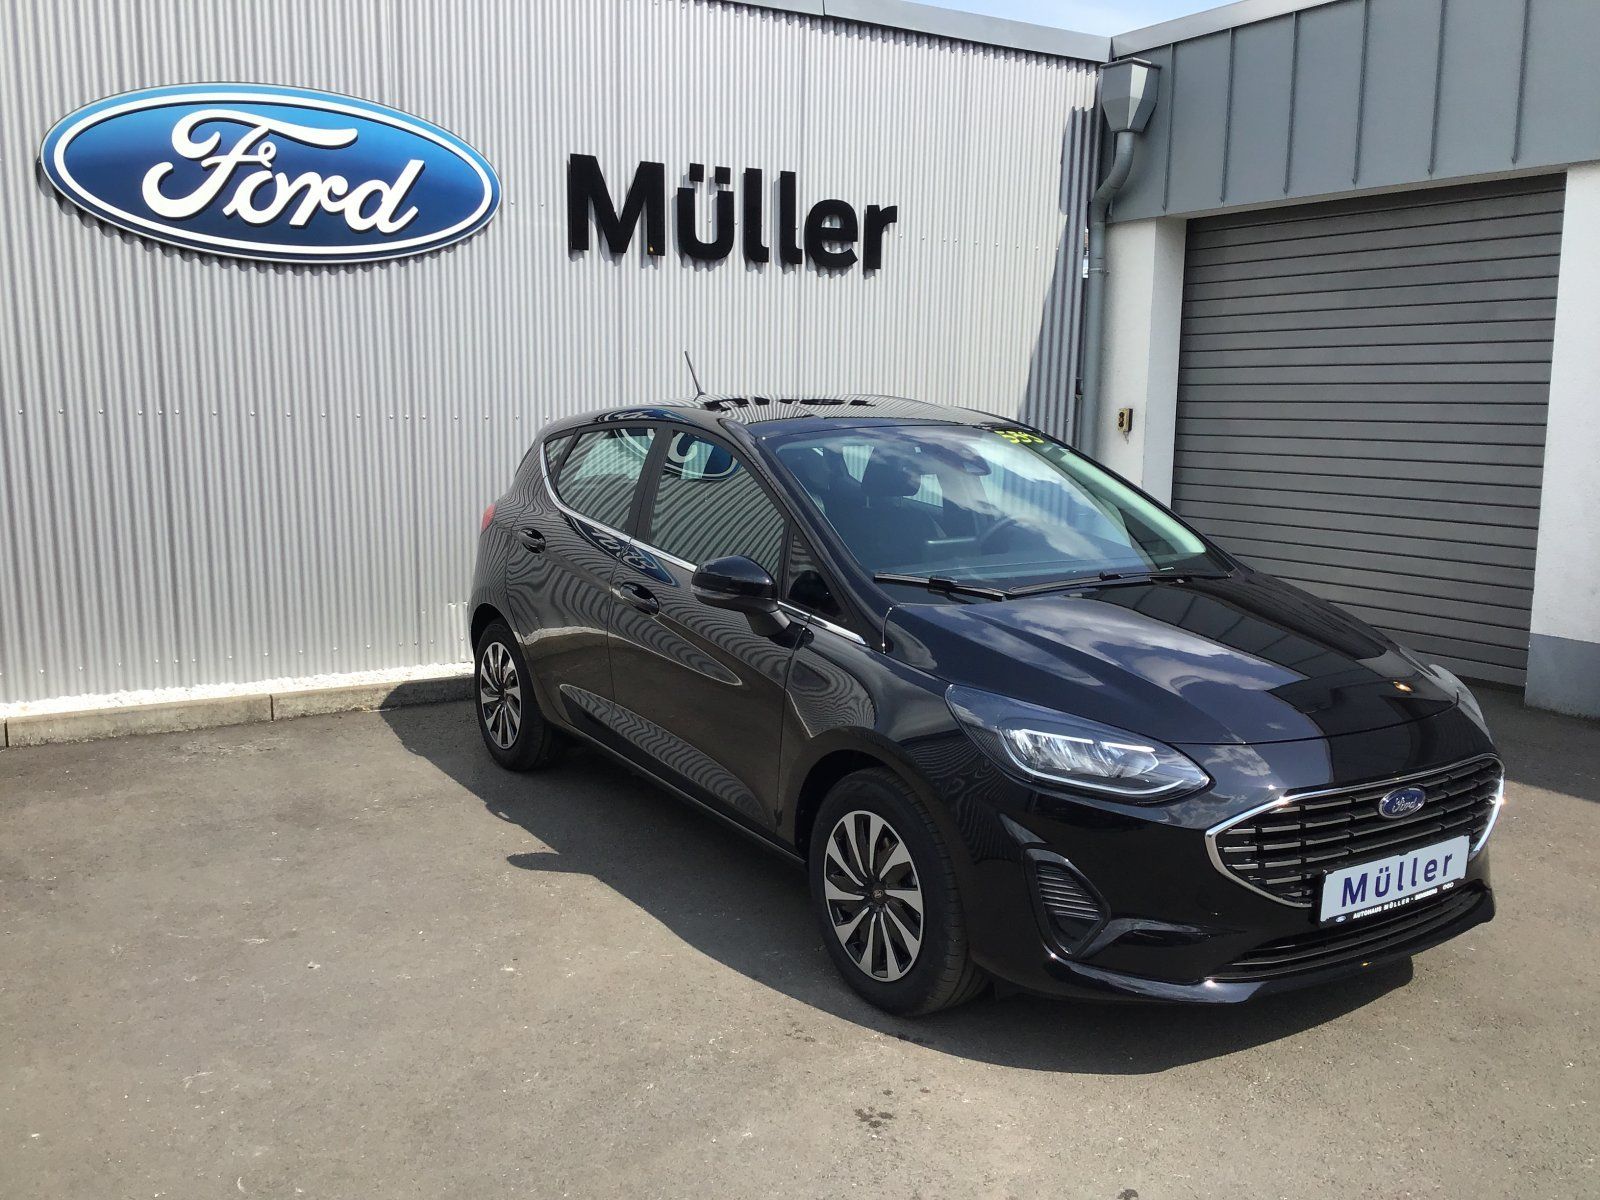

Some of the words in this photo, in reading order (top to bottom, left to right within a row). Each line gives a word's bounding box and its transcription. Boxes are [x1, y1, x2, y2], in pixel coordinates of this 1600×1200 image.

[142, 109, 425, 233] Ford
[569, 153, 898, 270] Müller
[1391, 796, 1418, 813] Ford
[1341, 853, 1453, 908] Müller
[1352, 906, 1382, 920] AUTOHAUS
